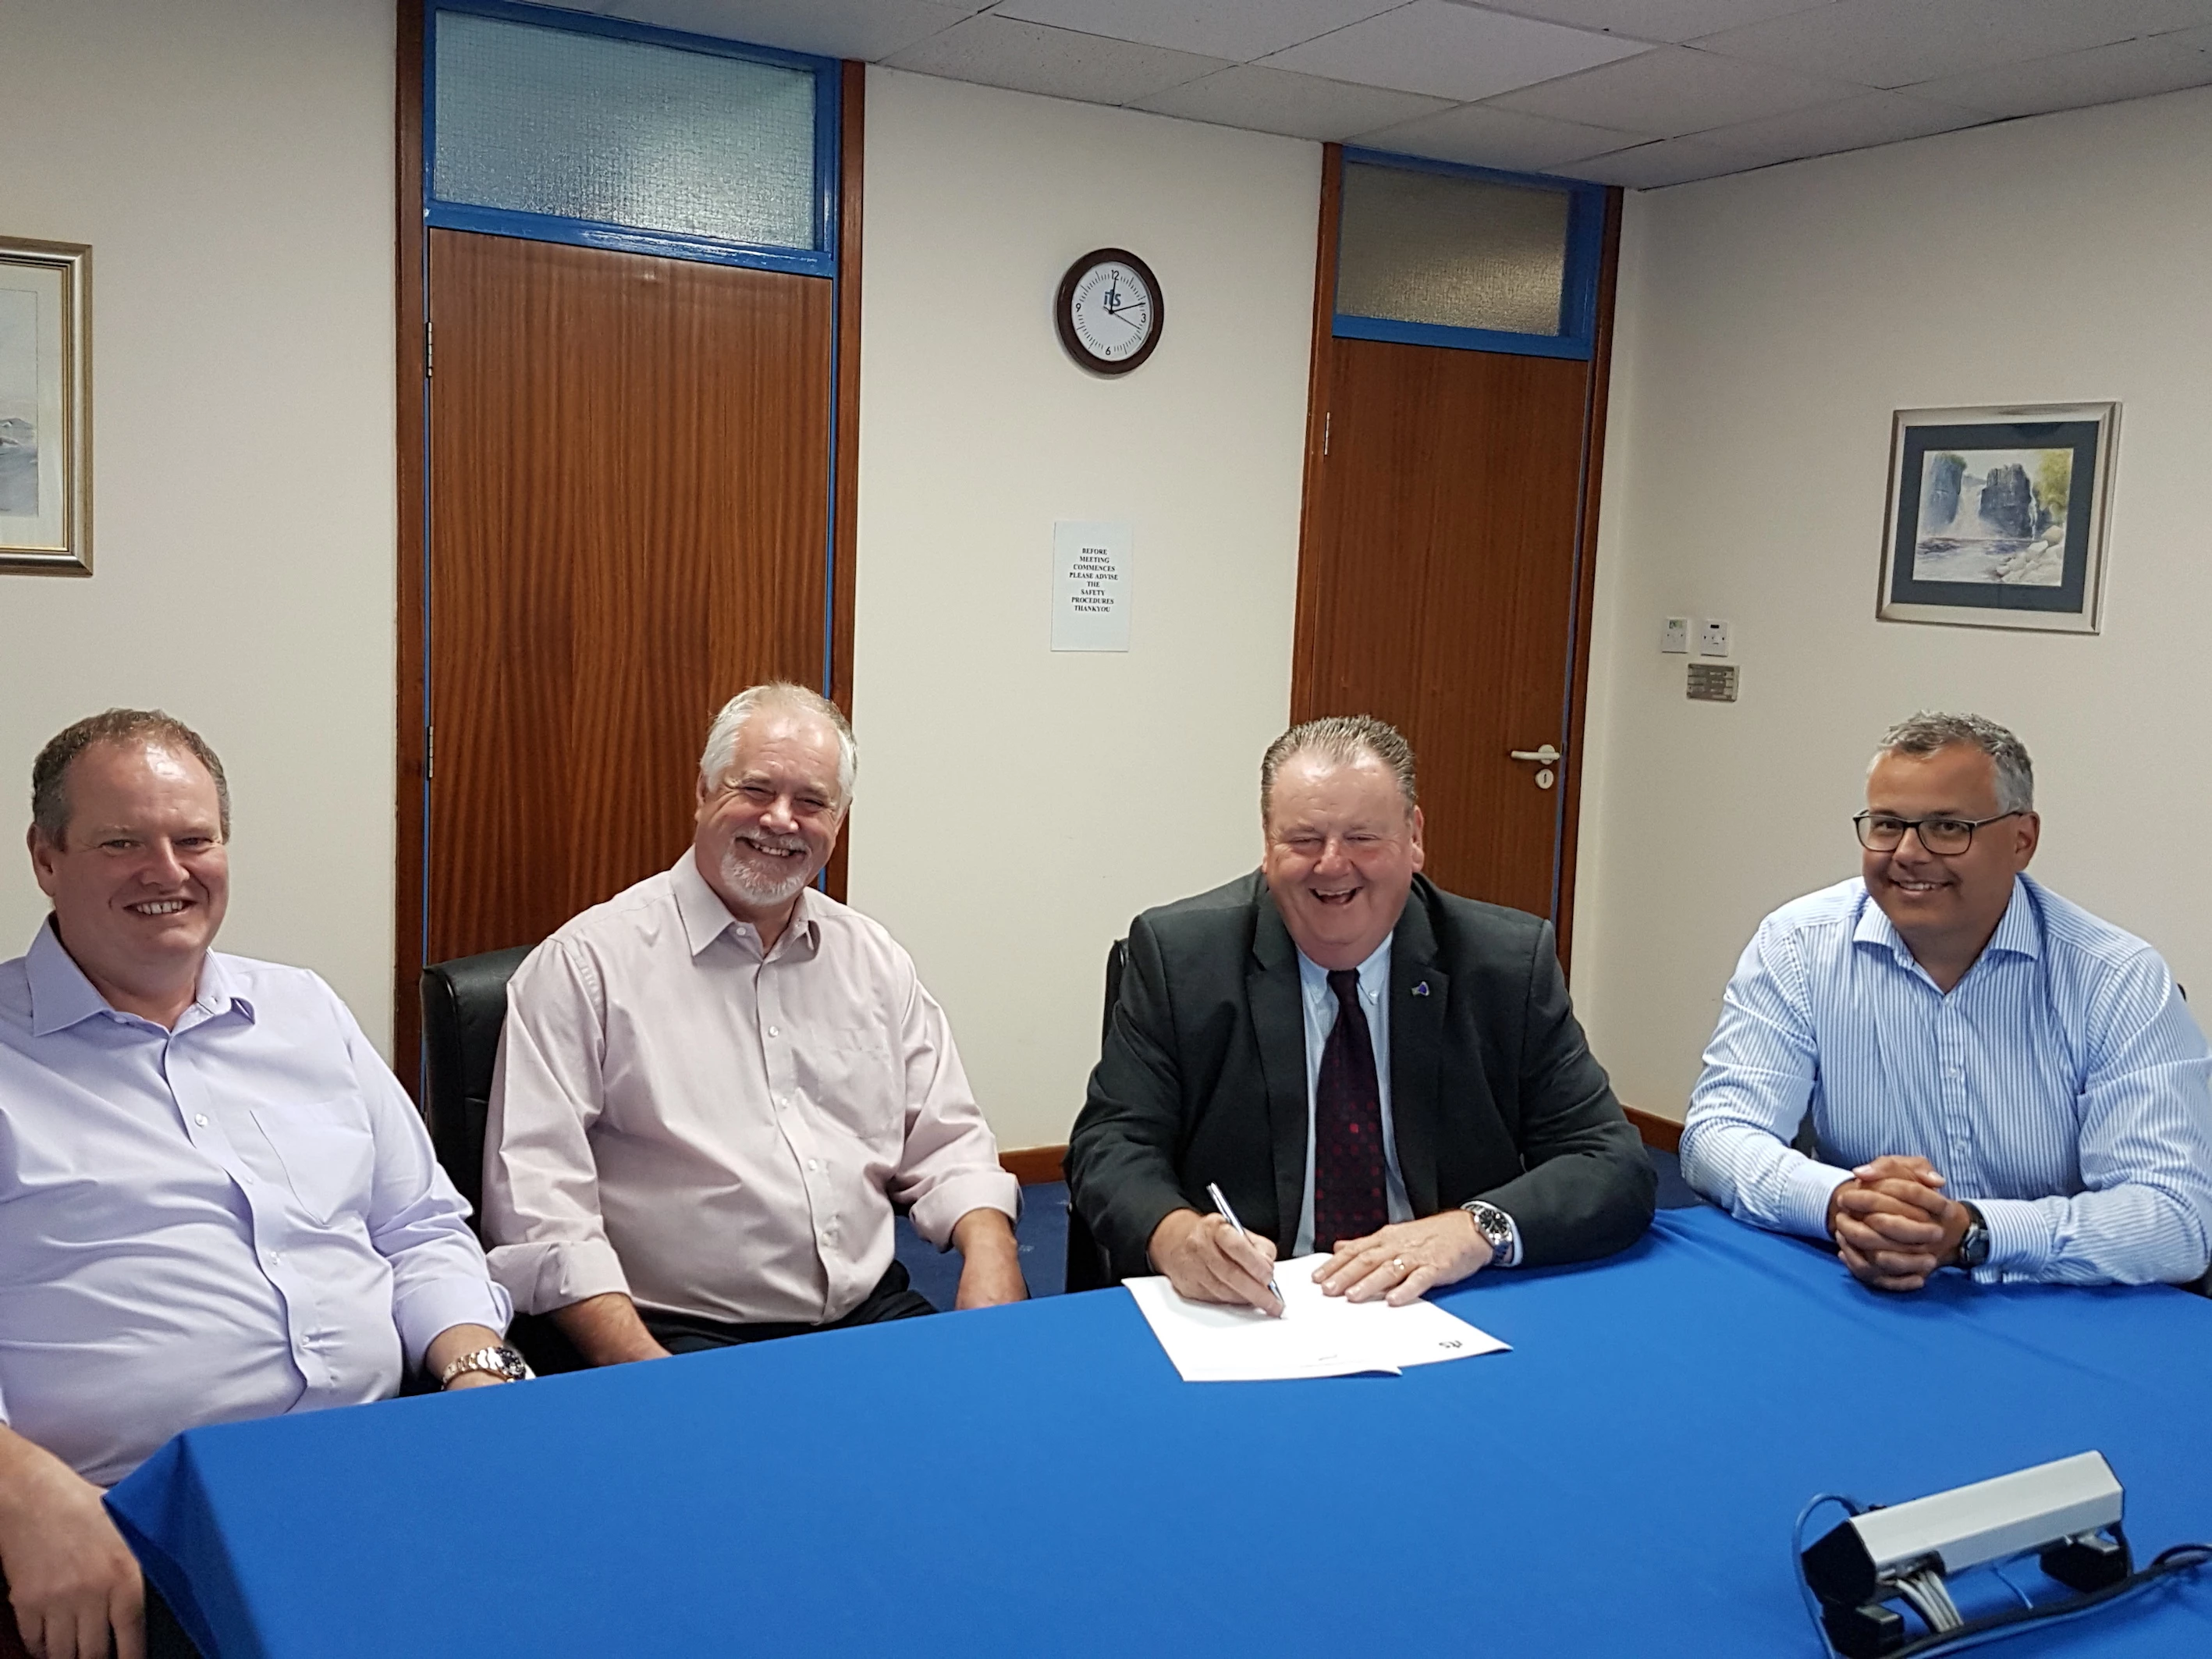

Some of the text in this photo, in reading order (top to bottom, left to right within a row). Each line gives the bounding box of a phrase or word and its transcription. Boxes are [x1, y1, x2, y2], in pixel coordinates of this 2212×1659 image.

[1111, 269, 1120, 281] 12
[1075, 303, 1081, 312] 9
[1141, 313, 1146, 323] 3
[1106, 346, 1111, 356] 6
